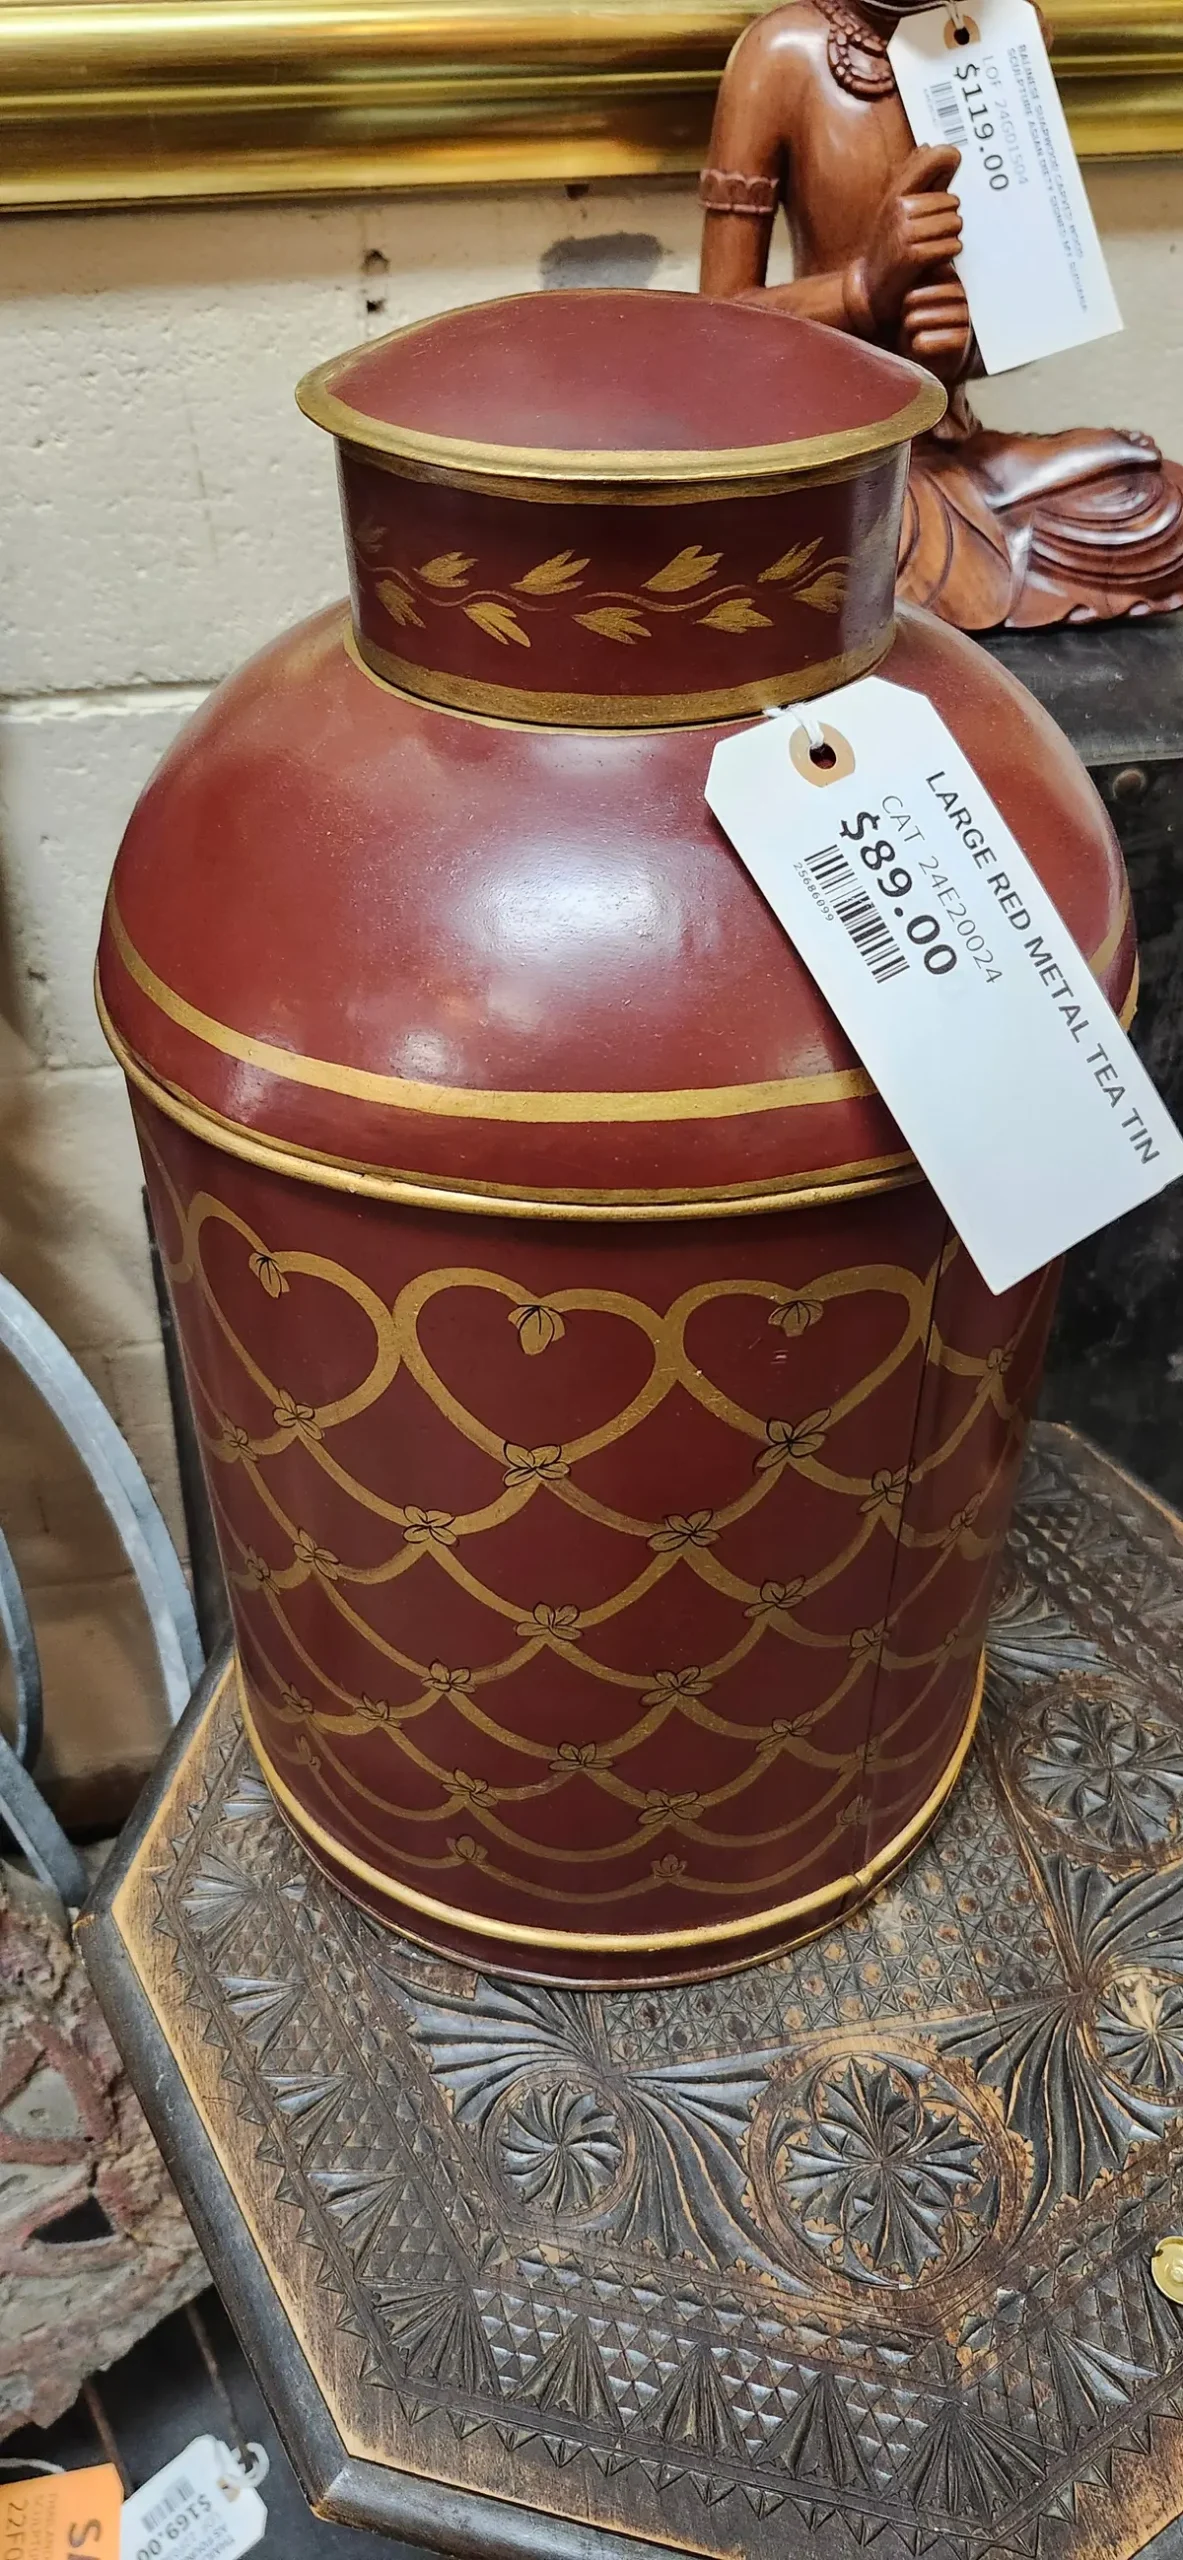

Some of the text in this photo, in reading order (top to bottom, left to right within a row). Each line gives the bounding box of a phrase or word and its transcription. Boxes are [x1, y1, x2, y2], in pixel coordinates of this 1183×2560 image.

[953, 63, 1010, 192] $119.00
[1007, 47, 1033, 116] SCULPTURE
[793, 860, 834, 921] 25686099
[839, 812, 957, 975] $89.00
[882, 796, 1001, 983] CAT 24E20024
[926, 771, 1160, 1164] LARGE RED METAL TEA TIN
